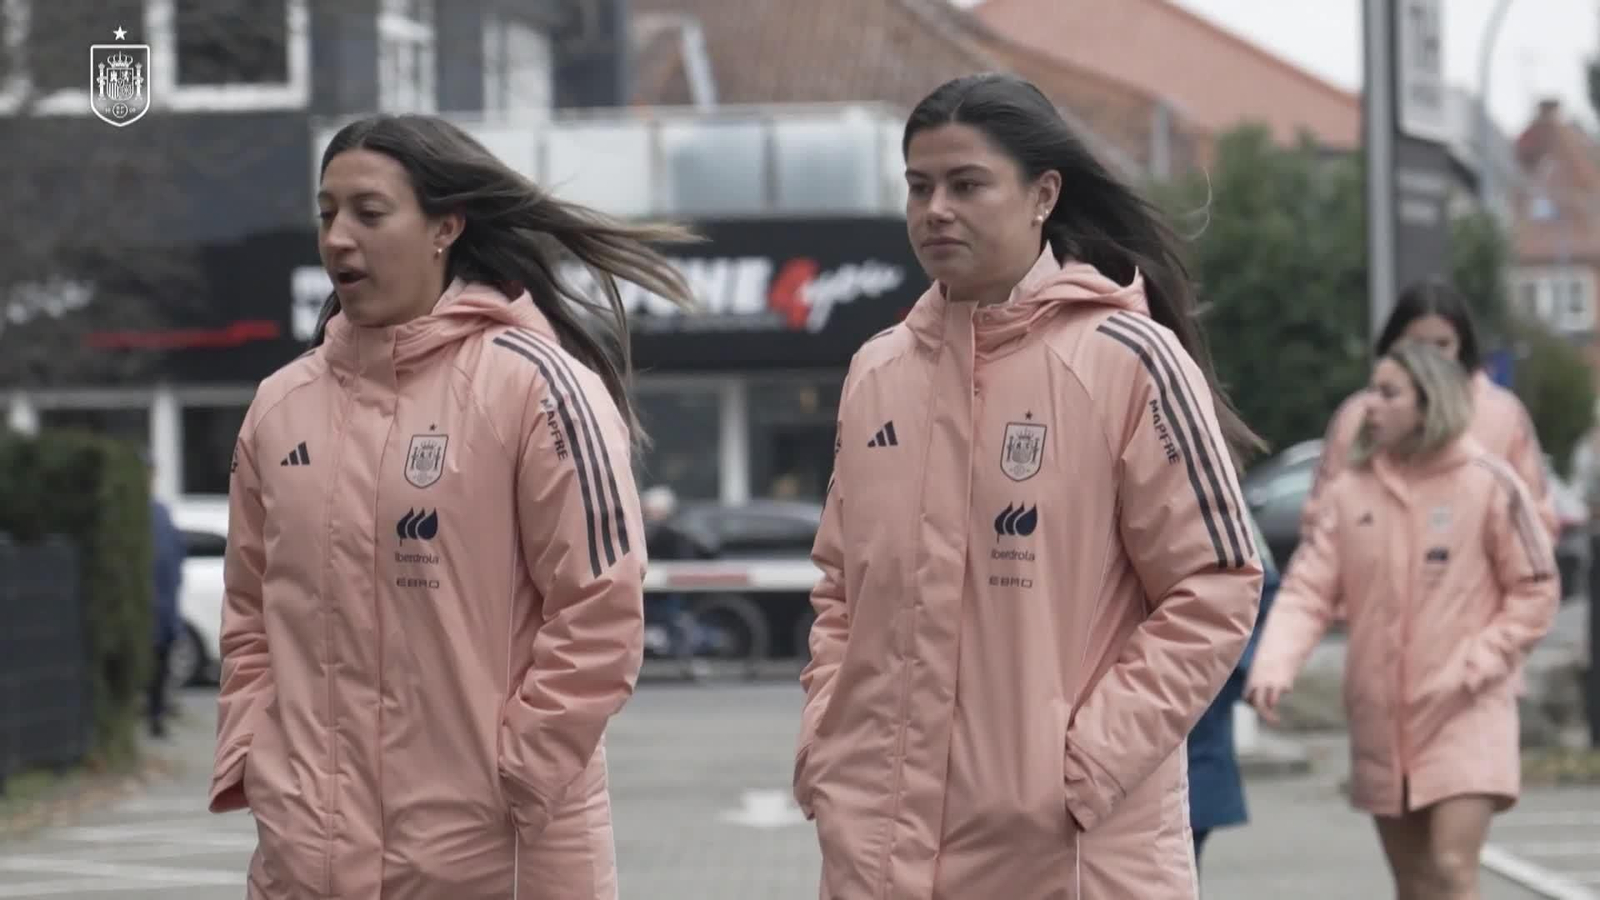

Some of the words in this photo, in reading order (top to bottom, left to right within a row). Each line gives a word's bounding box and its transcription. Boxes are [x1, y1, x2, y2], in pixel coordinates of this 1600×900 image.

[540, 399, 569, 461] MAPFRE
[1149, 399, 1181, 465] MAPFRE
[394, 551, 440, 565] Iberdrola
[991, 549, 1036, 562] Iberdrola
